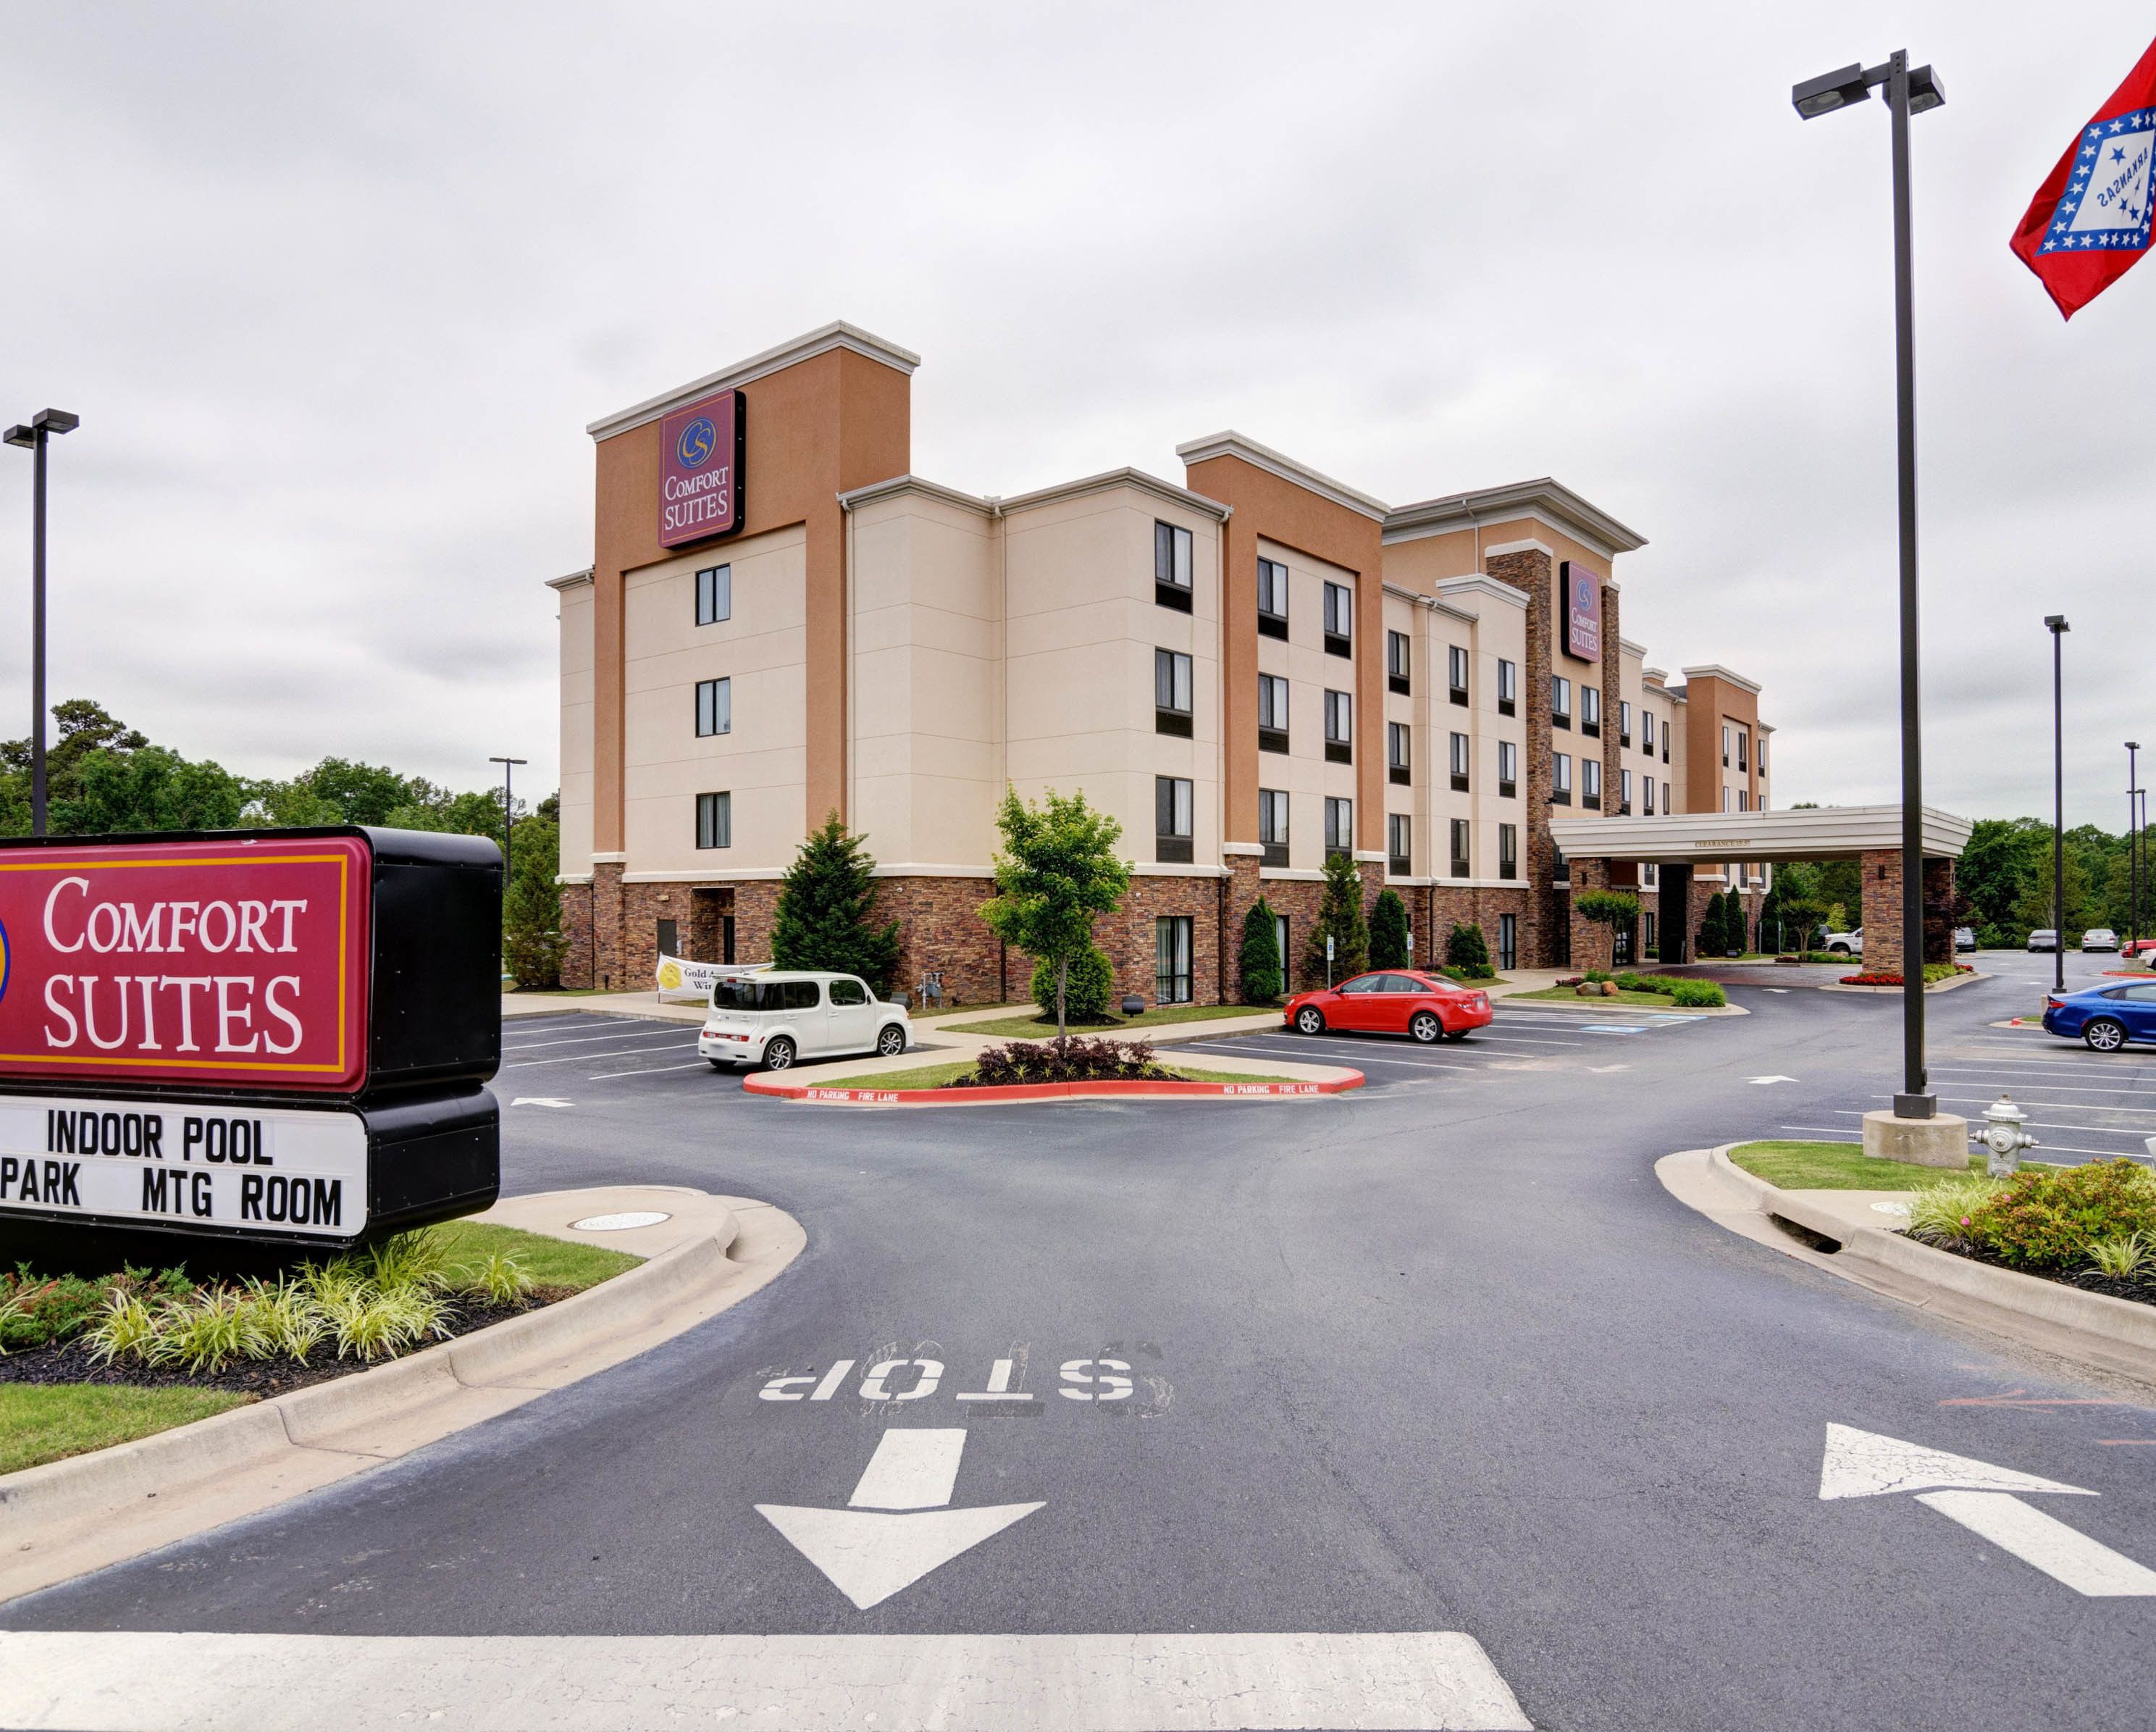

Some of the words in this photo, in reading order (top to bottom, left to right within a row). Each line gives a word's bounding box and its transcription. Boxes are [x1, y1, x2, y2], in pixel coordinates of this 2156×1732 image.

[665, 467, 729, 501] COMFORT
[665, 490, 728, 530] SUITES
[1571, 607, 1598, 632] COMFORT
[1572, 627, 1598, 651] SUITES
[43, 877, 307, 953] COMFORT
[684, 968, 706, 978] Gold
[44, 974, 303, 1055] SUITES
[807, 1089, 817, 1099] NO
[819, 1090, 850, 1100] PARKING
[858, 1092, 875, 1101] FIRE
[877, 1092, 898, 1102] LANE
[1224, 1085, 1234, 1095] NO
[1238, 1085, 1270, 1094] PARKING
[1279, 1085, 1296, 1094] FIRE
[1299, 1084, 1319, 1093] LANE
[48, 1110, 163, 1158] INDOOR
[183, 1117, 273, 1166] POOL
[1, 1158, 80, 1206] PARK
[142, 1168, 213, 1218] MTG
[241, 1174, 341, 1226] ROOM
[758, 1359, 1133, 1401] STOP
